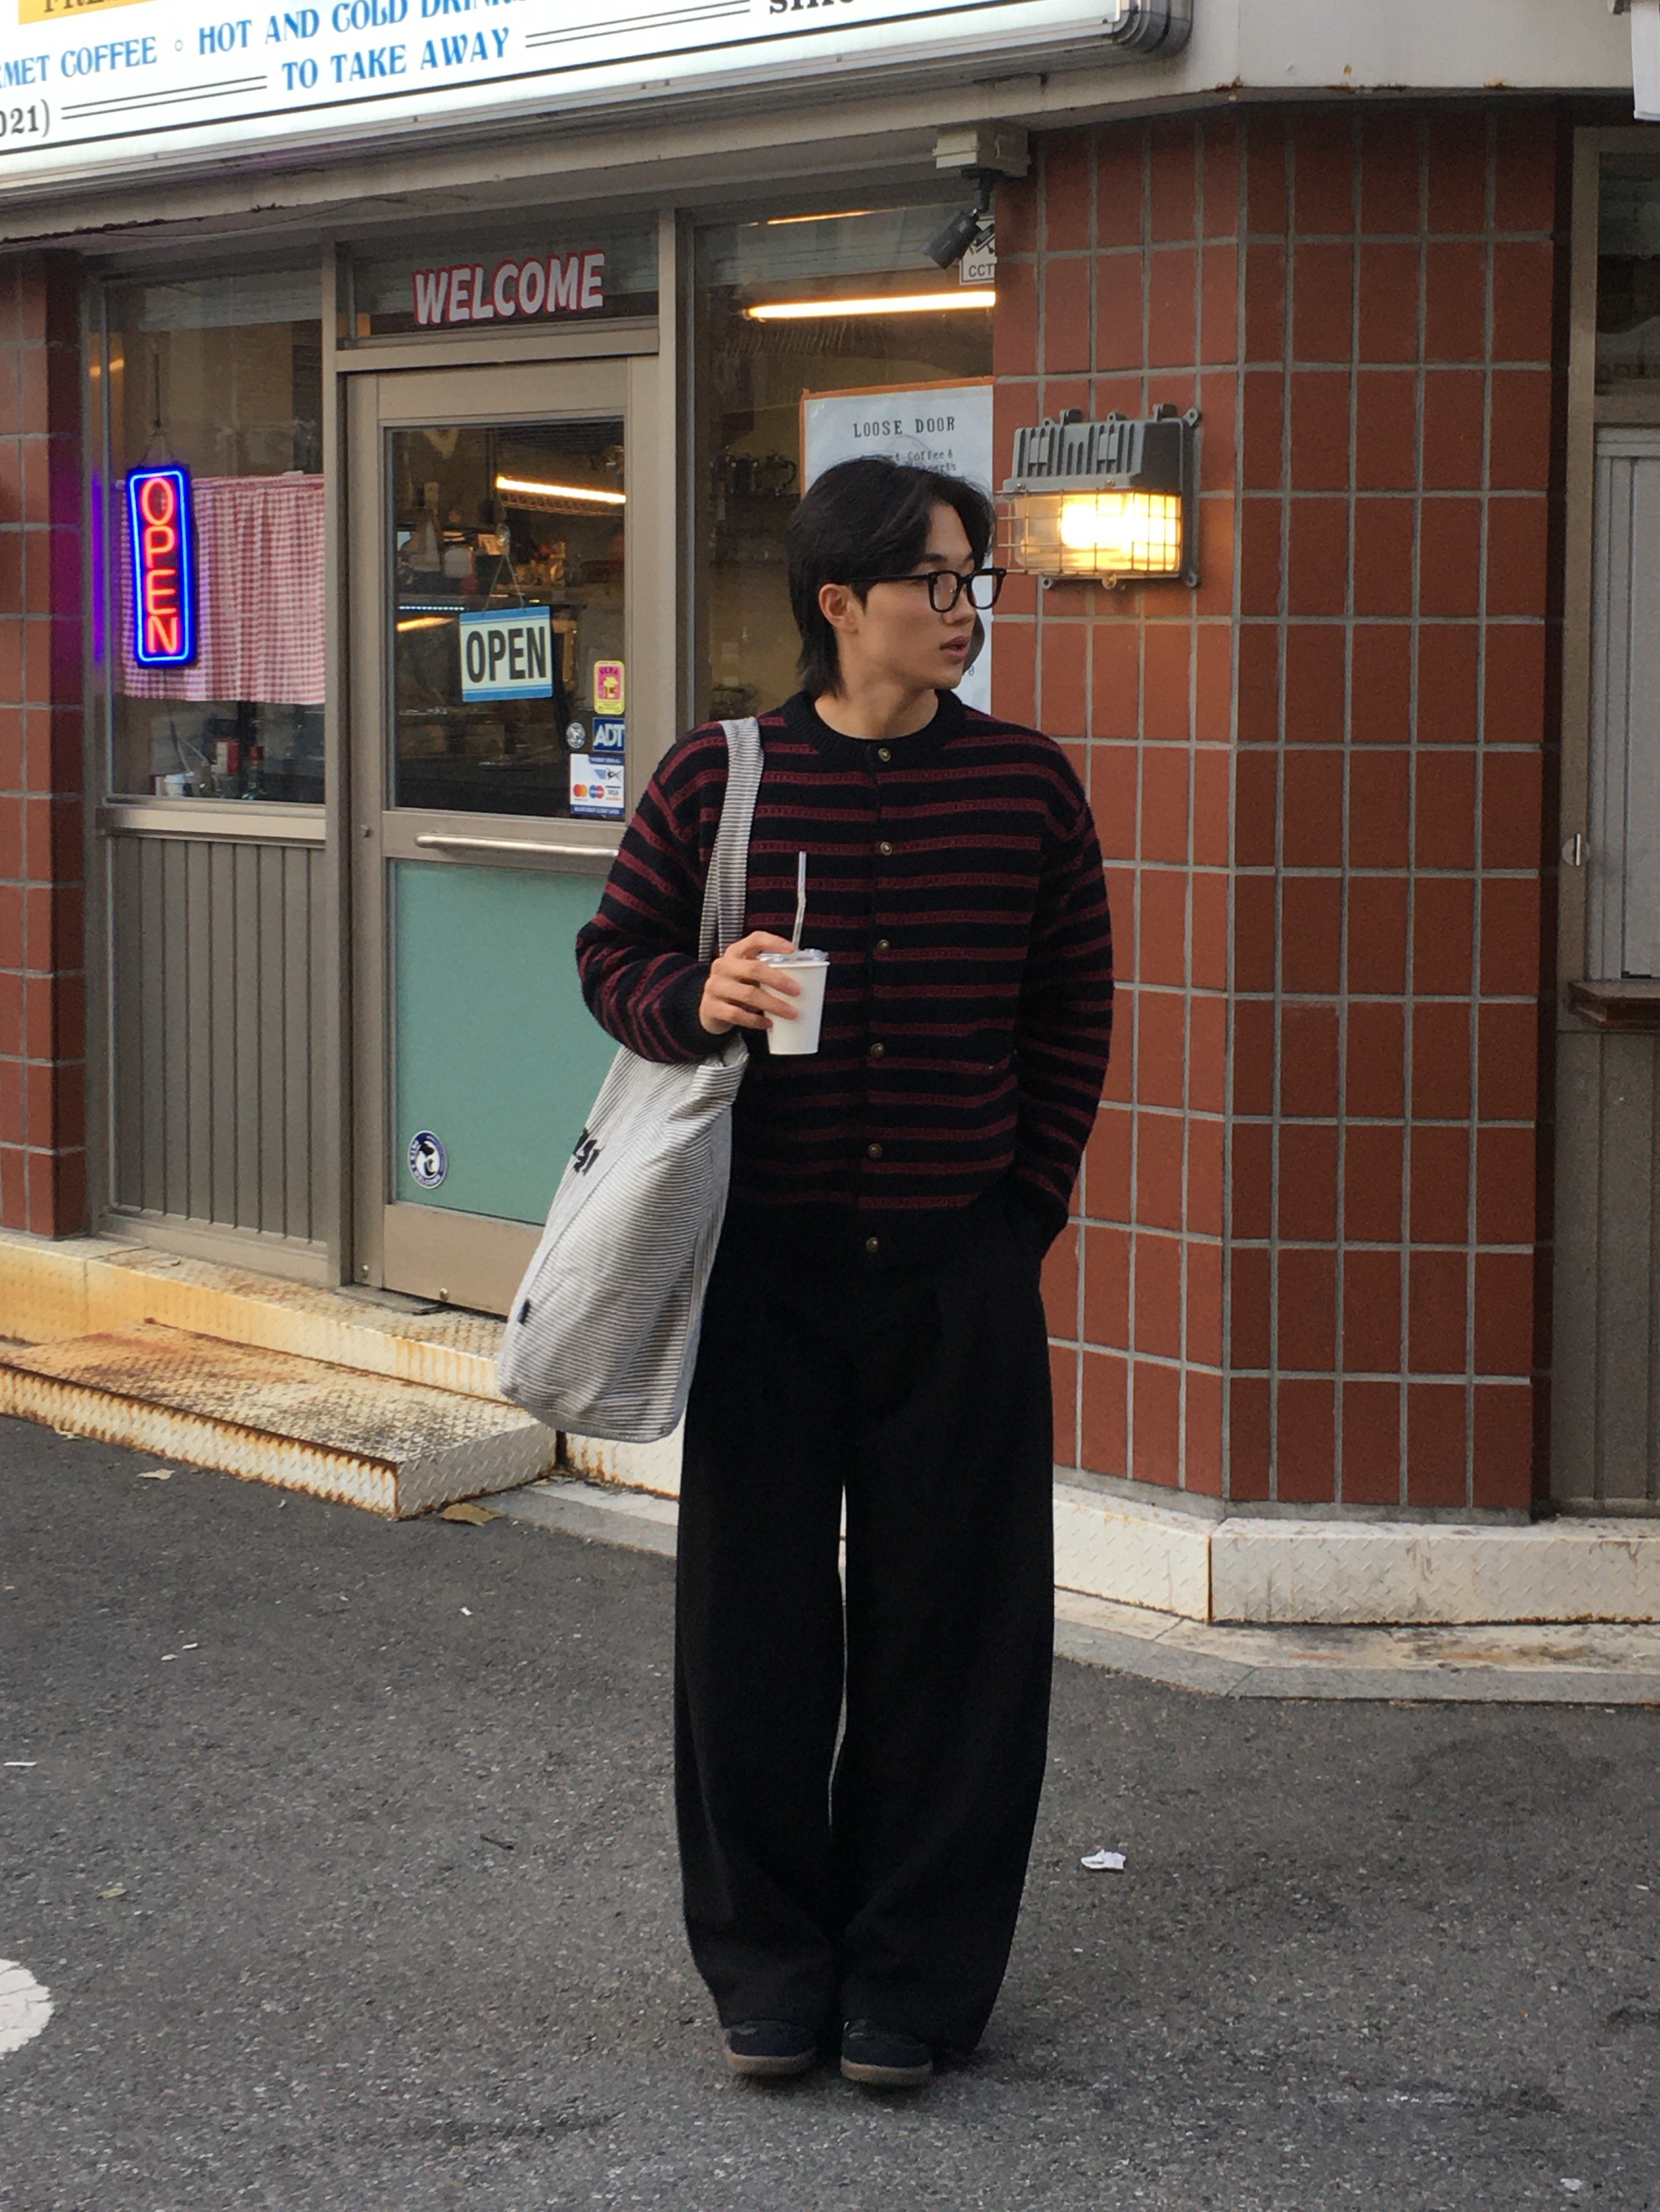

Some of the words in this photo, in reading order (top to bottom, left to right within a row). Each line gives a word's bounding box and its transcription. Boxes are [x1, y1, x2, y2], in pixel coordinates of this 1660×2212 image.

[0, 54, 50, 89] MET
[60, 36, 158, 78] COFFEE
[199, 19, 252, 55] HOT
[265, 8, 320, 44] AND
[331, 0, 408, 32] COLD
[281, 58, 318, 91] TO
[330, 44, 407, 83] TAKE
[420, 27, 509, 71] AWAY
[412, 249, 605, 324] WELCOME
[968, 263, 996, 278] CCT
[853, 420, 903, 438] LOOSE
[914, 416, 955, 433] DOOR
[140, 476, 180, 655] OPEN
[466, 626, 546, 683] OPEN
[593, 724, 626, 748] ADT
